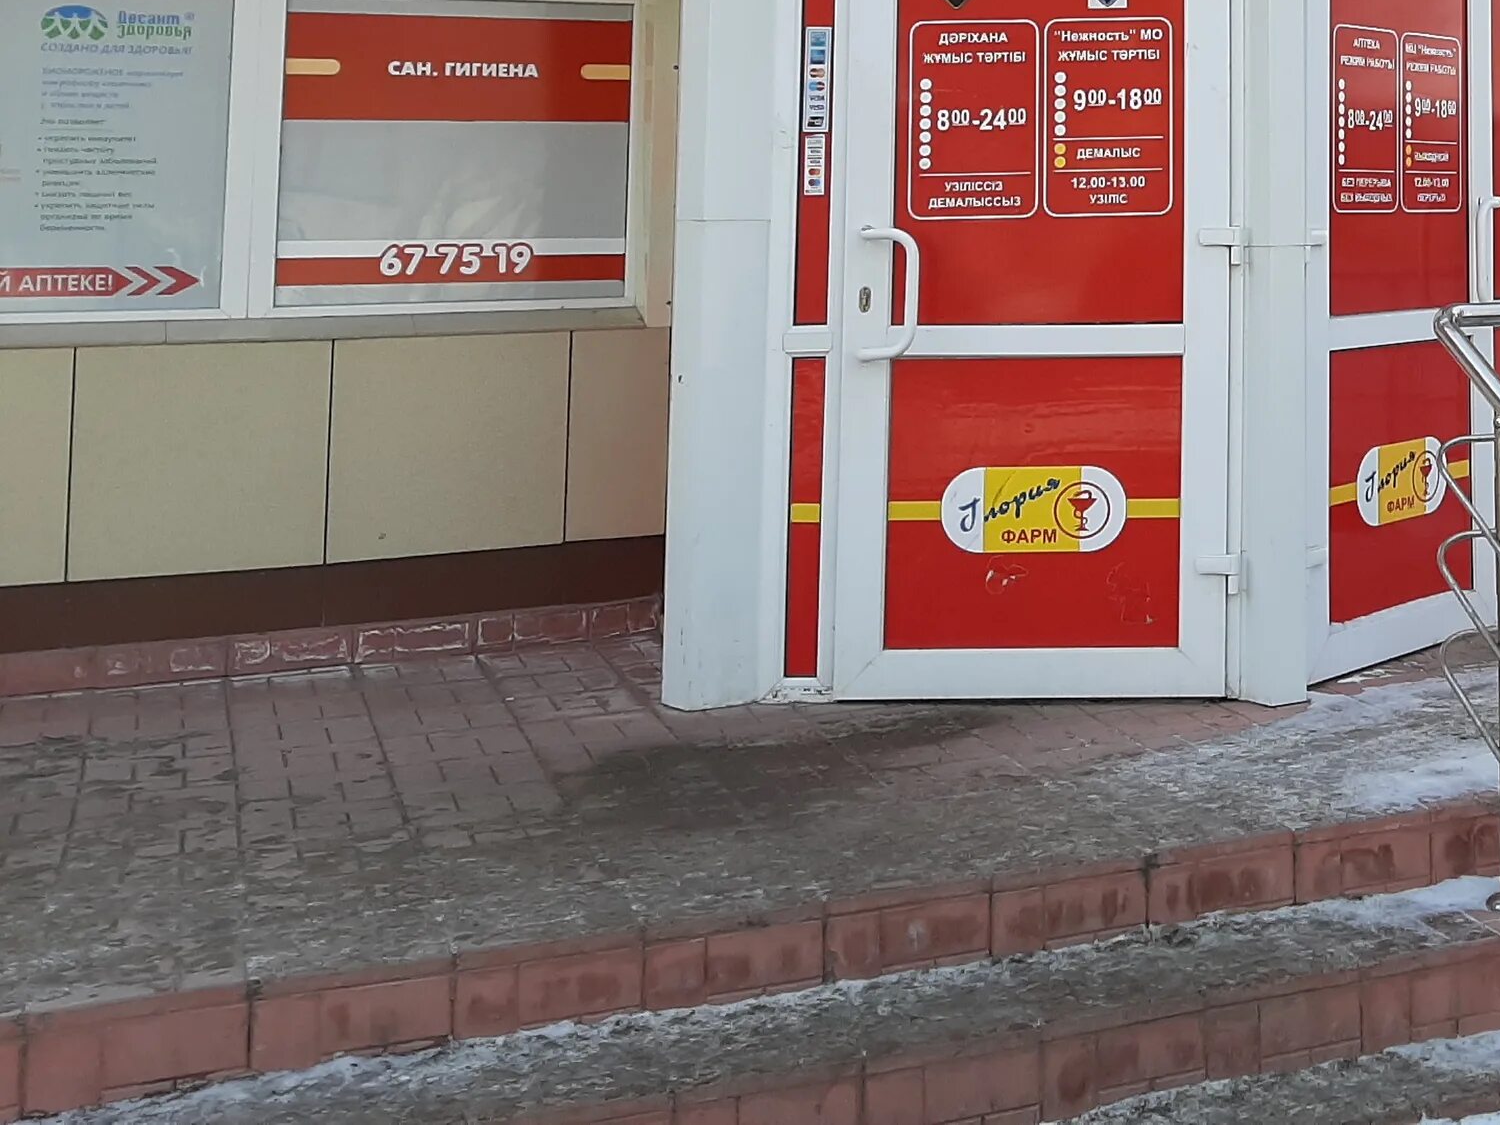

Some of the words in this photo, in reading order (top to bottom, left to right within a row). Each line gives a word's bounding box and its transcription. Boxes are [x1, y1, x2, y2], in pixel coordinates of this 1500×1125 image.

[938, 32, 1008, 46] ДӘРІХАНА
[1140, 28, 1164, 41] МО
[977, 51, 1027, 63] ТӘРТІБІ
[387, 61, 438, 77] САН.
[444, 63, 538, 78] ГИГИЕНА
[1076, 146, 1141, 159] ДЕМАЛЫС
[928, 196, 1021, 209] ДЕМАЛЫССЫЗ
[380, 246, 426, 276] 67
[438, 246, 482, 275] 75
[495, 244, 531, 274] 19
[18, 274, 113, 292] АПТЕКЕ!
[957, 477, 1061, 533] Глория
[1386, 495, 1415, 514] ФАРМ
[1001, 528, 1057, 544] ФАРМ
